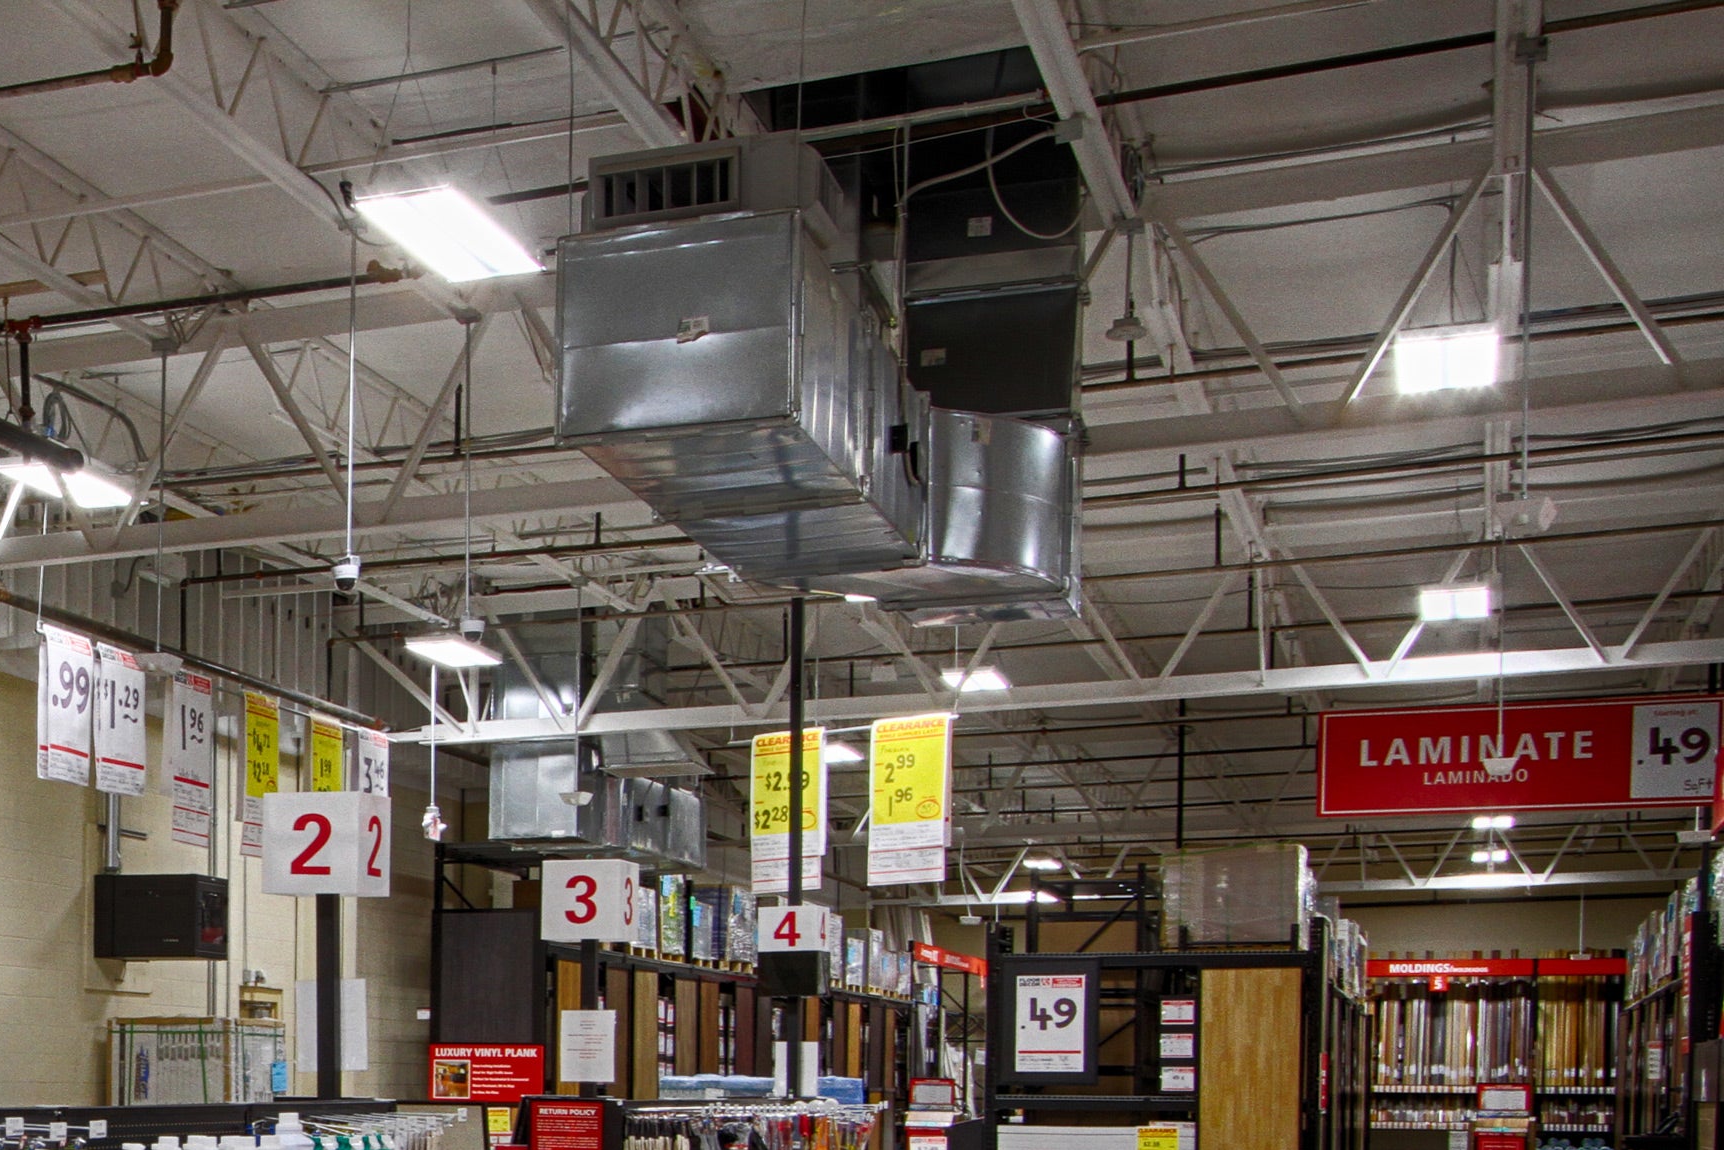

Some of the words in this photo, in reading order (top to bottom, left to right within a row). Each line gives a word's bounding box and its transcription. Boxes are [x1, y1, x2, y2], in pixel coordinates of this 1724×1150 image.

[52, 661, 90, 714] .99
[875, 718, 945, 734] CLEARANCE
[1359, 729, 1594, 767] LAMINATE
[1637, 726, 1712, 766] .49
[290, 812, 332, 876] 2
[366, 814, 383, 878] 2
[564, 874, 598, 925] 3
[623, 876, 634, 926] 3
[773, 911, 802, 948] 4
[1389, 963, 1451, 974] MOLDINGS
[1021, 997, 1078, 1031] .49
[435, 1047, 473, 1057] LUXURY
[473, 1047, 503, 1058] VINYL
[504, 1048, 538, 1058] PLANK
[539, 1107, 568, 1116] RETURN
[569, 1108, 597, 1117] POLICY
